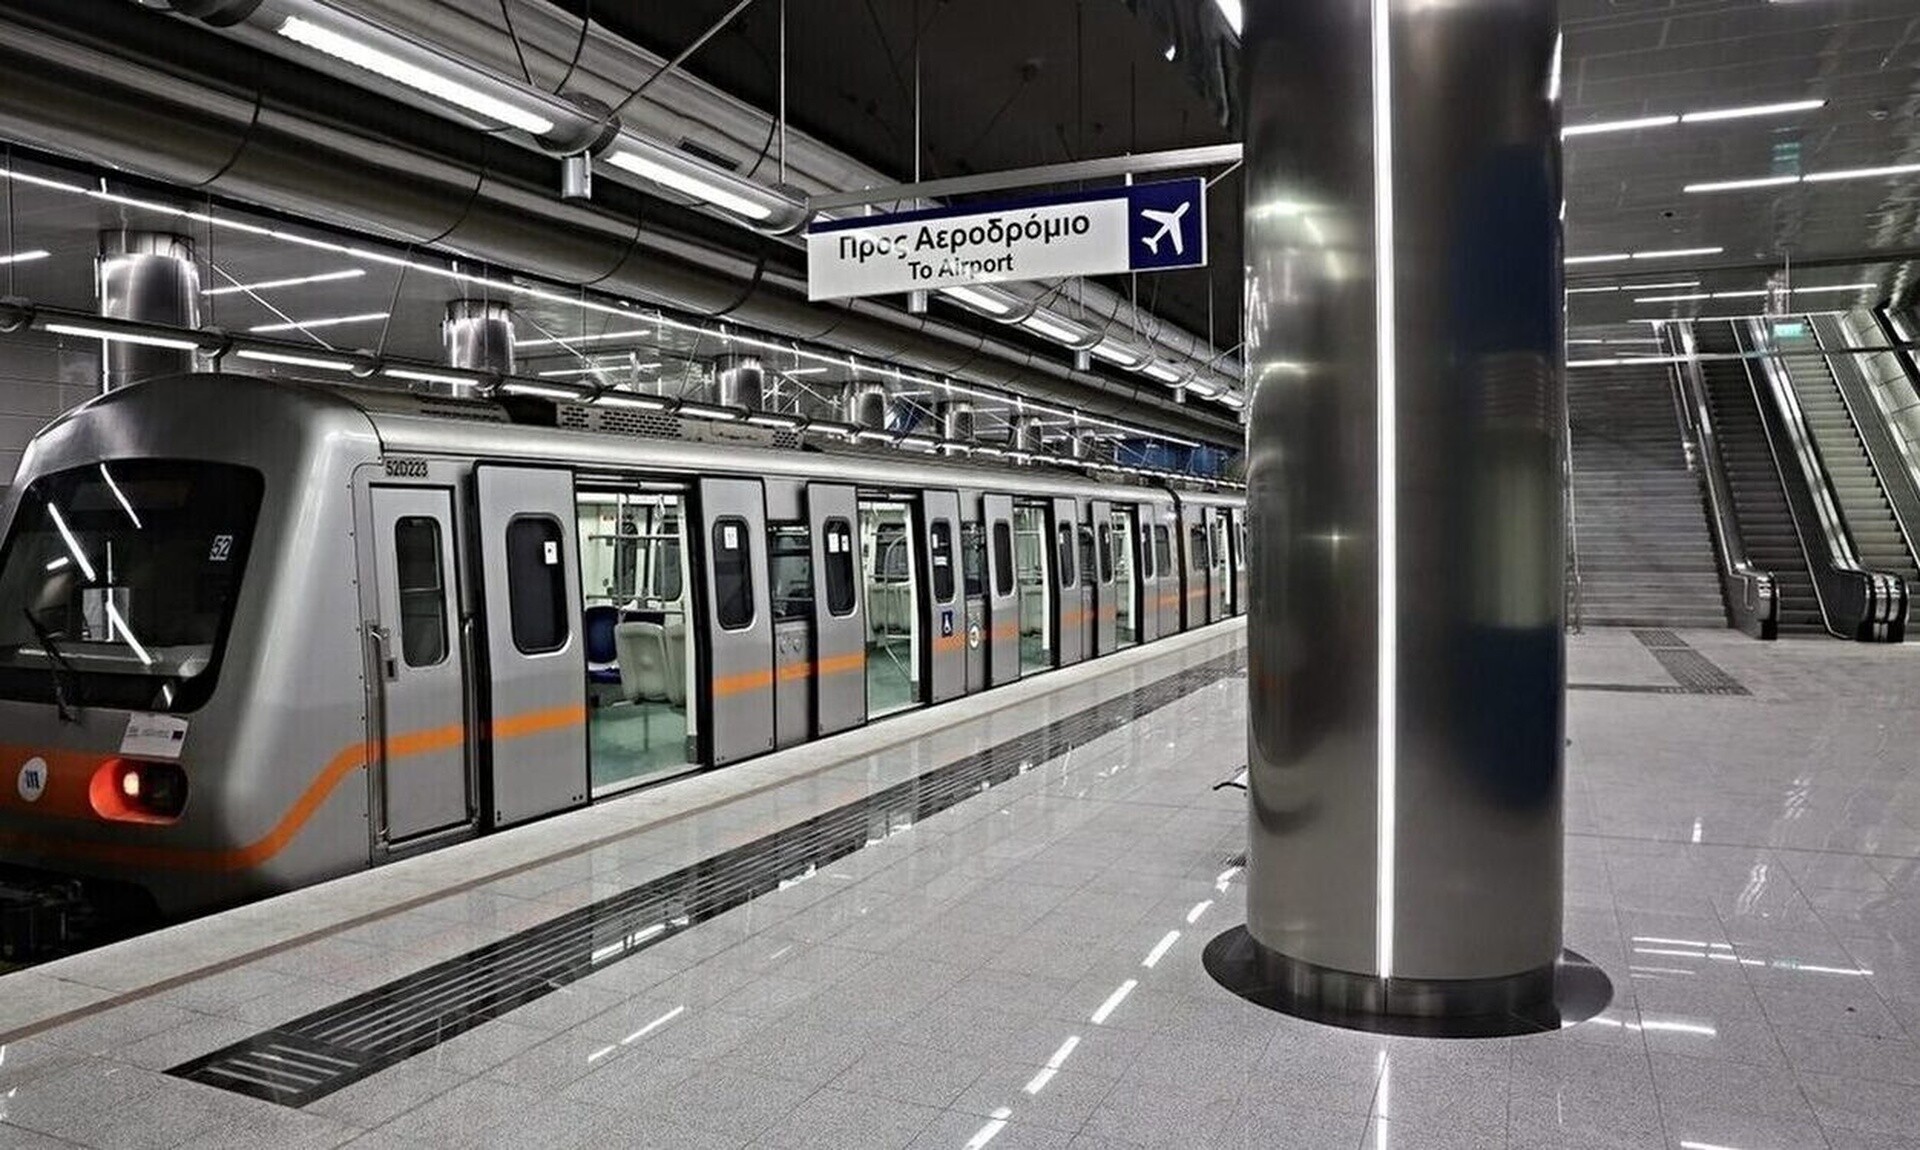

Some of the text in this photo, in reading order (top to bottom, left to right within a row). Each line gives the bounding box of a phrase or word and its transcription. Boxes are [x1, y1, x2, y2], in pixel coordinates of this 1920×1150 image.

[839, 213, 1090, 263] Προς Αεροδρόμιο
[908, 253, 1014, 280] To Airport
[211, 537, 231, 558] 52
